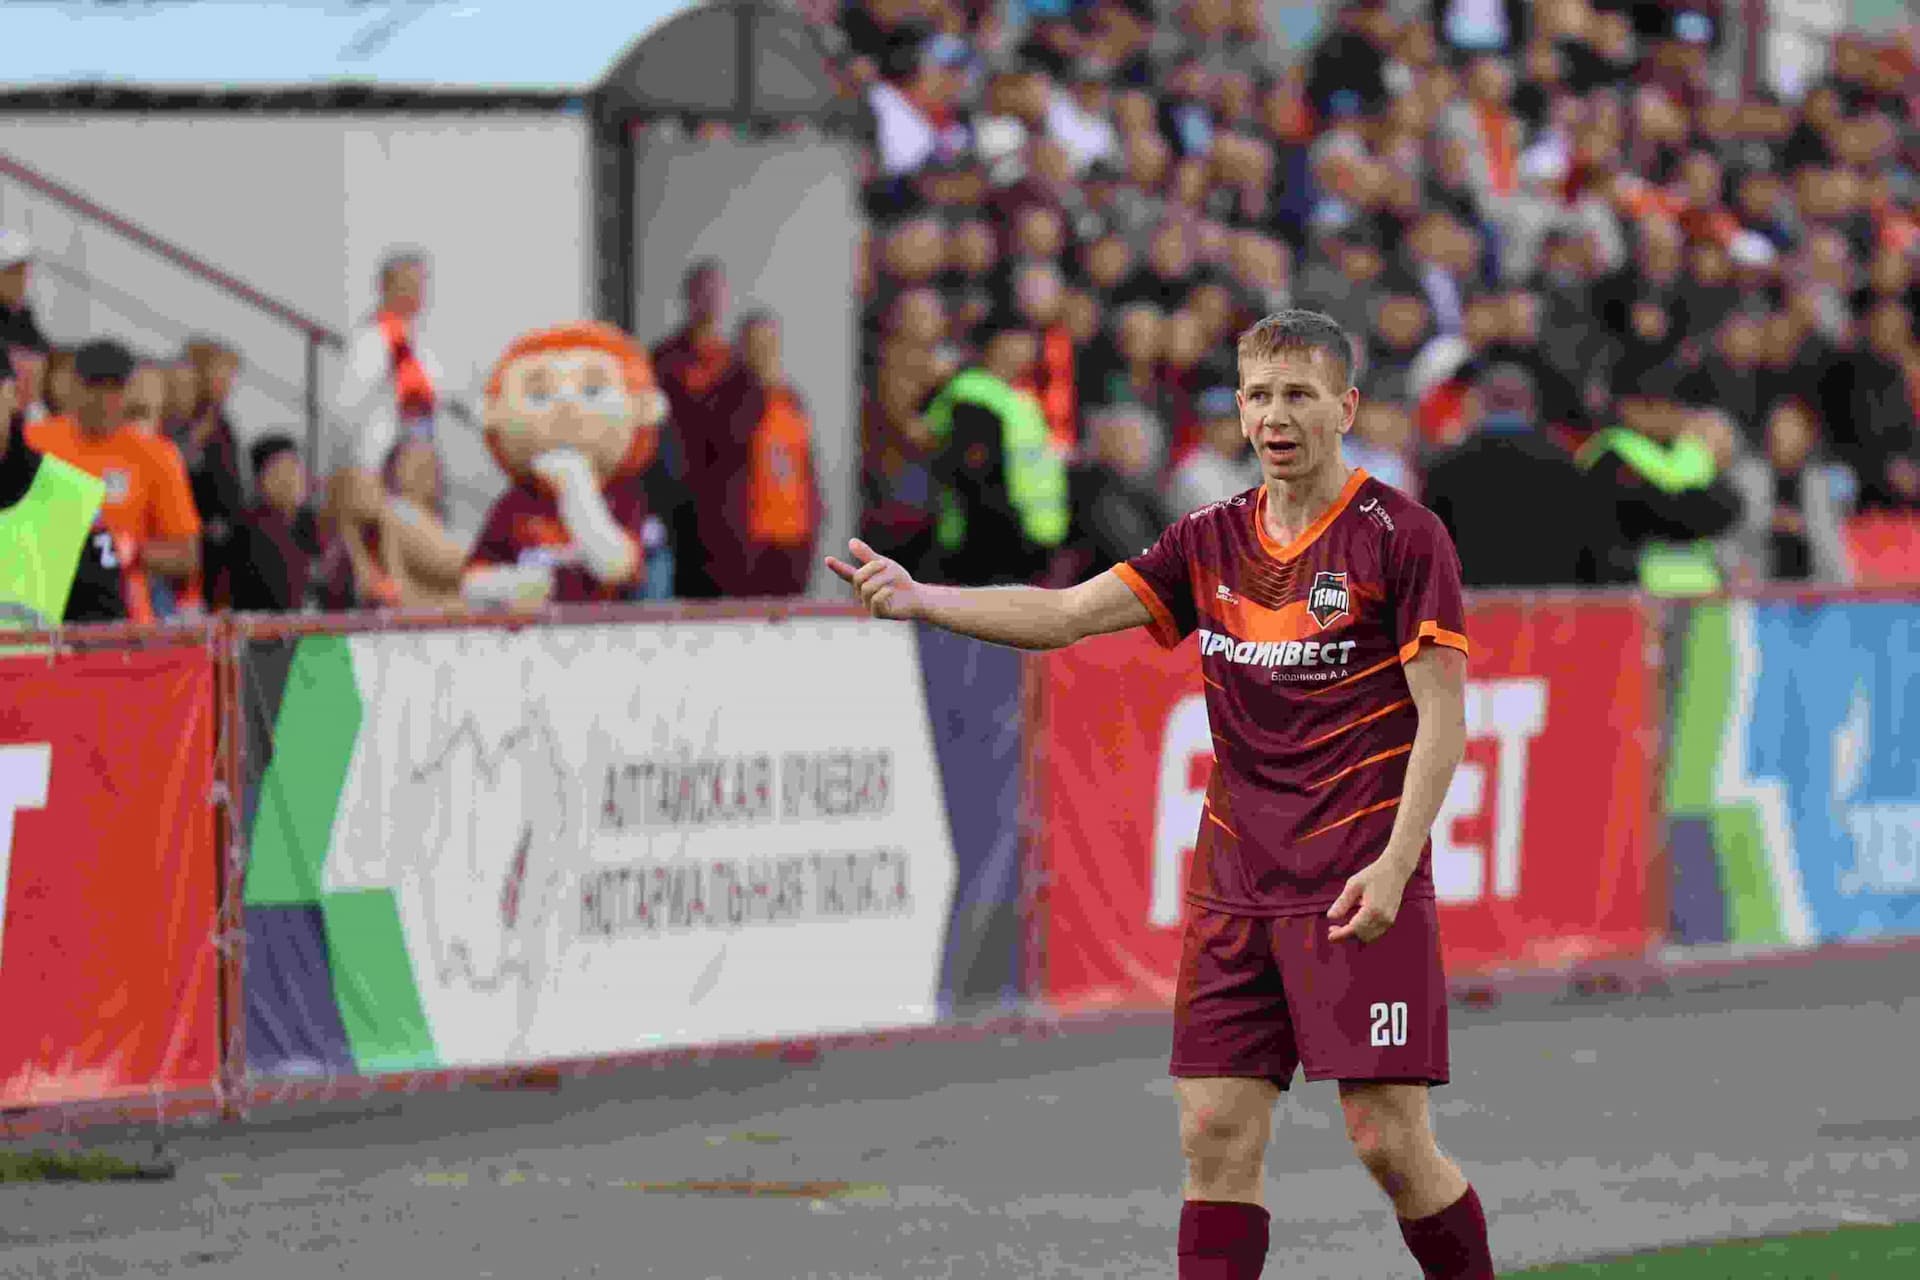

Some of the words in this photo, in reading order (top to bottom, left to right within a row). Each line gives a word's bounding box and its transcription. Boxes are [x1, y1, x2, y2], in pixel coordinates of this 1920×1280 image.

[1313, 587, 1347, 609] ТЕМП
[1199, 628, 1357, 668] ПРОДИНВЕСТ
[1271, 671, 1327, 683] Бродников
[1370, 1001, 1408, 1047] 20
